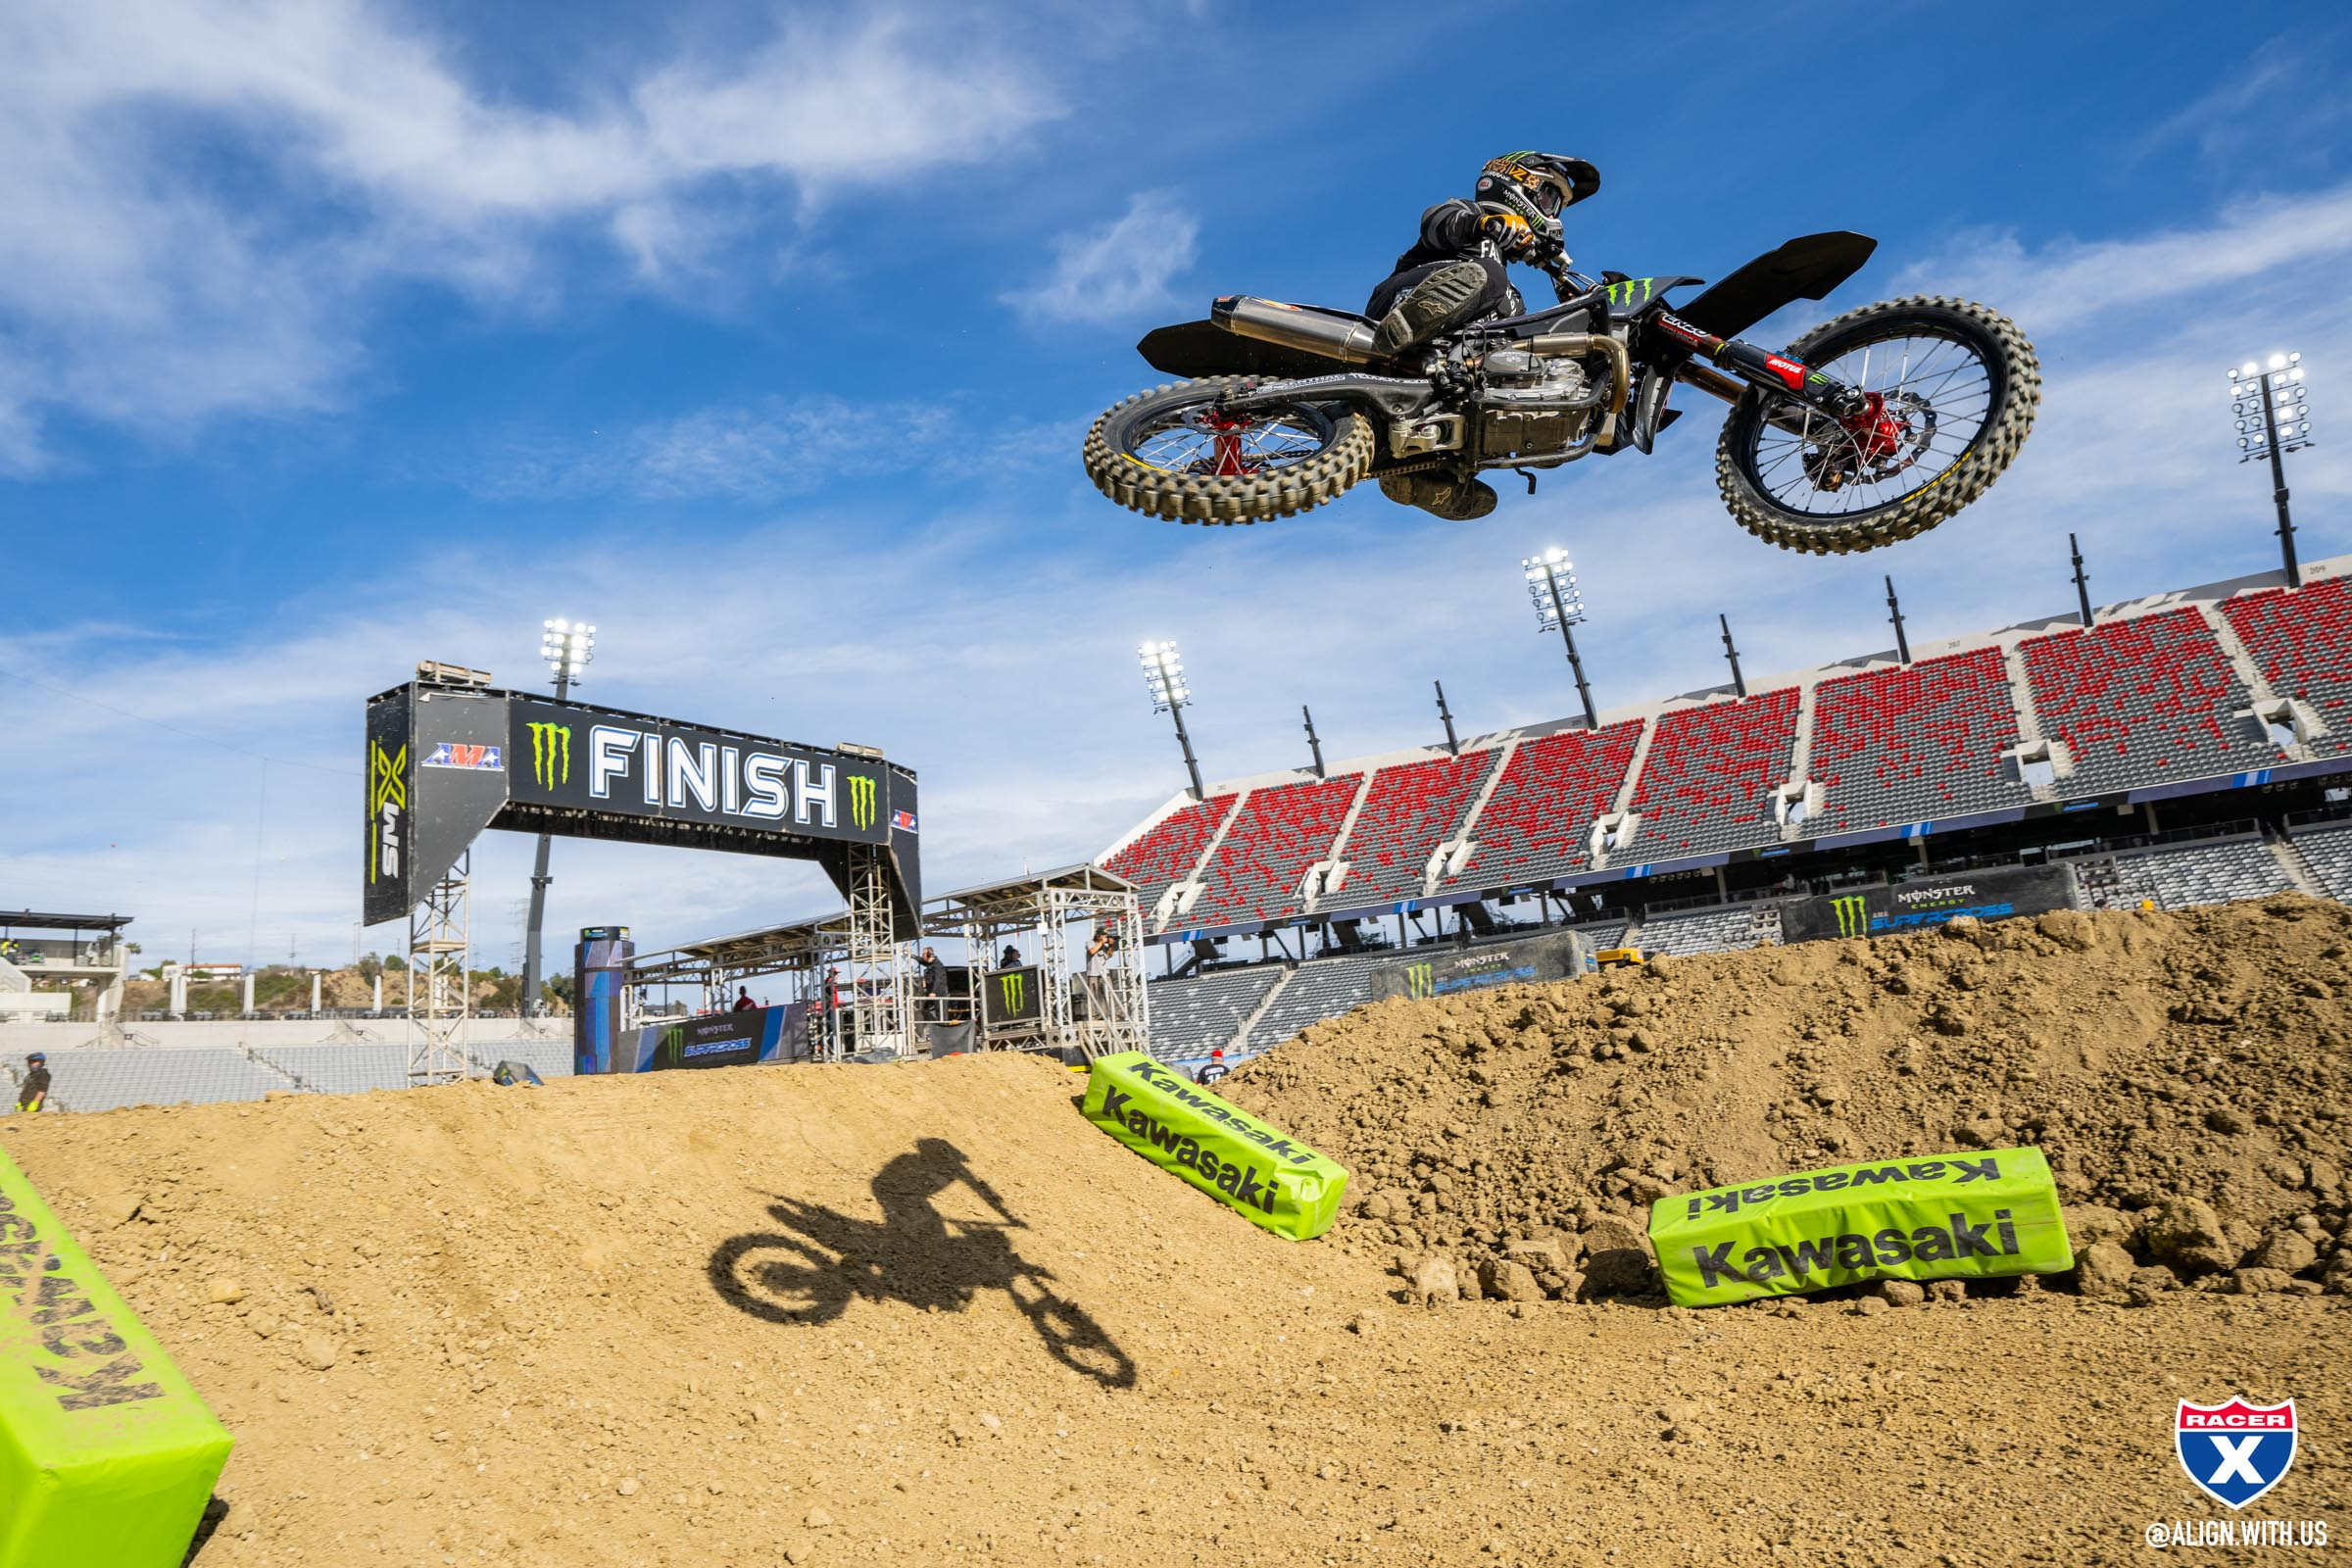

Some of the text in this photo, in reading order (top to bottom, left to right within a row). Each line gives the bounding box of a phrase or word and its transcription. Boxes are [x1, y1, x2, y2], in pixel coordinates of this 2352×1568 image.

[1508, 165, 1528, 182] VZ
[1502, 188, 1537, 219] MONSTER
[1768, 358, 1802, 374] MOTUL
[421, 743, 505, 771] AMA
[589, 724, 838, 828] FINISH
[1897, 885, 1976, 904] MONSTER
[1911, 898, 1966, 909] ENERGY
[1871, 902, 2015, 930] SUPERCROSS
[1454, 952, 1510, 969] MONSTER
[683, 1037, 753, 1057] SUPERCROSS
[1127, 1061, 1318, 1165] Kawasaki
[1102, 1085, 1280, 1215] Kawasaki
[1686, 1157, 2002, 1221] Kawasaki
[1692, 1207, 2021, 1290] Kawasaki
